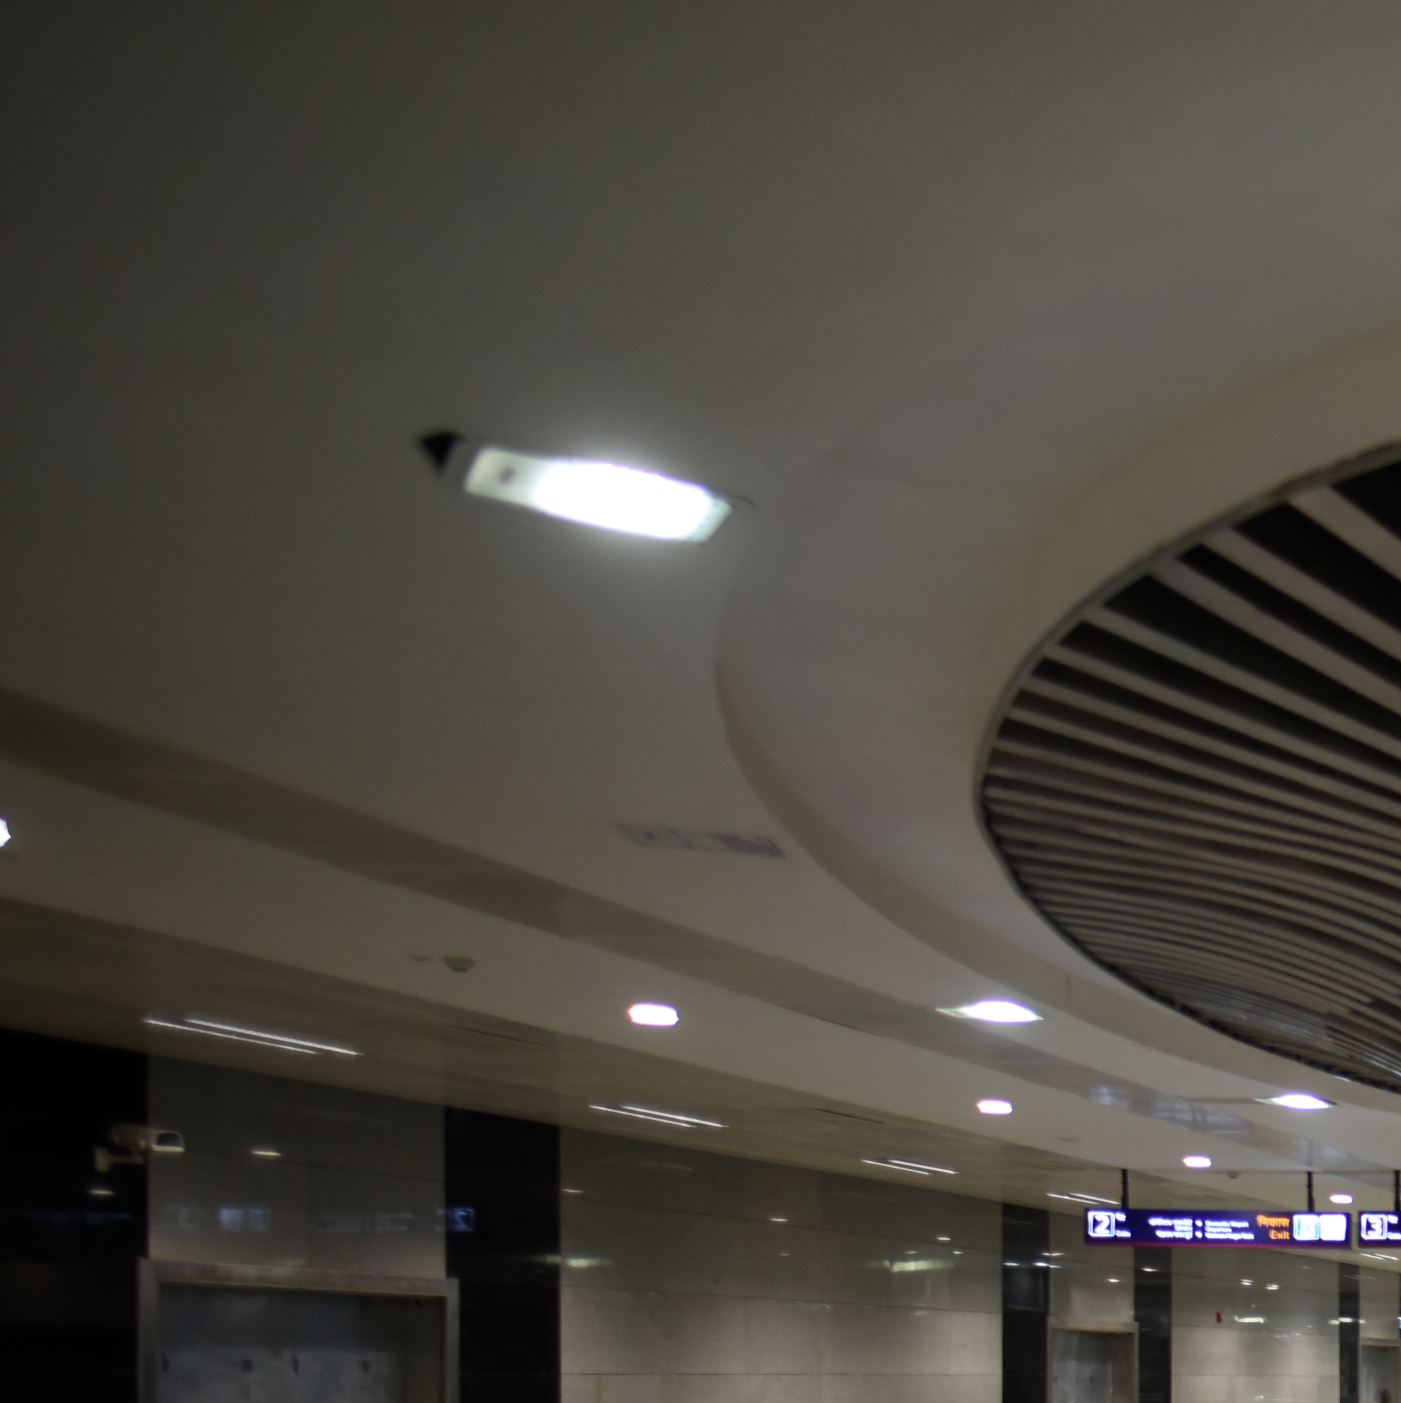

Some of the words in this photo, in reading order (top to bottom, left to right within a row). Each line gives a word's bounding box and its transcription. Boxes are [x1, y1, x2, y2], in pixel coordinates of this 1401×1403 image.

[1094, 1215, 1110, 1234] 2
[1367, 1216, 1382, 1236] 3
[1269, 1230, 1290, 1240] Exit
